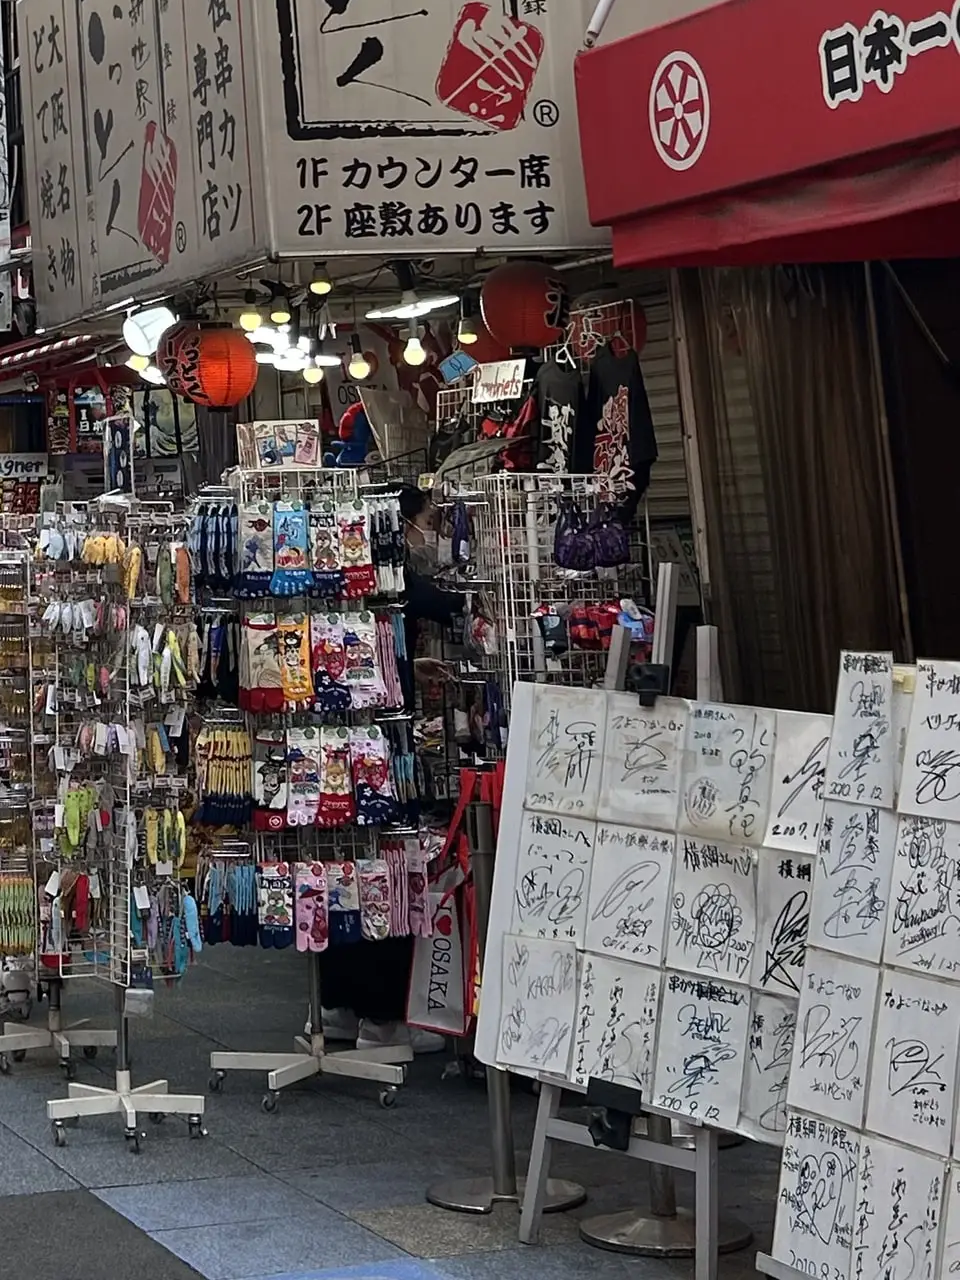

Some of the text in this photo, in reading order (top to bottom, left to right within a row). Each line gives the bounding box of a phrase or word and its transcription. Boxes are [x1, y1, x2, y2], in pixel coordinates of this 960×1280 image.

[821, 13, 949, 107] 日本一
[32, 23, 60, 293] どて焼き
[47, 14, 77, 289] 大阪名物
[192, 42, 220, 243] 専門店
[296, 153, 552, 191] 1F カウンター席
[297, 199, 557, 238] 2F 座敷あります
[427, 937, 452, 1015] OSAKA
